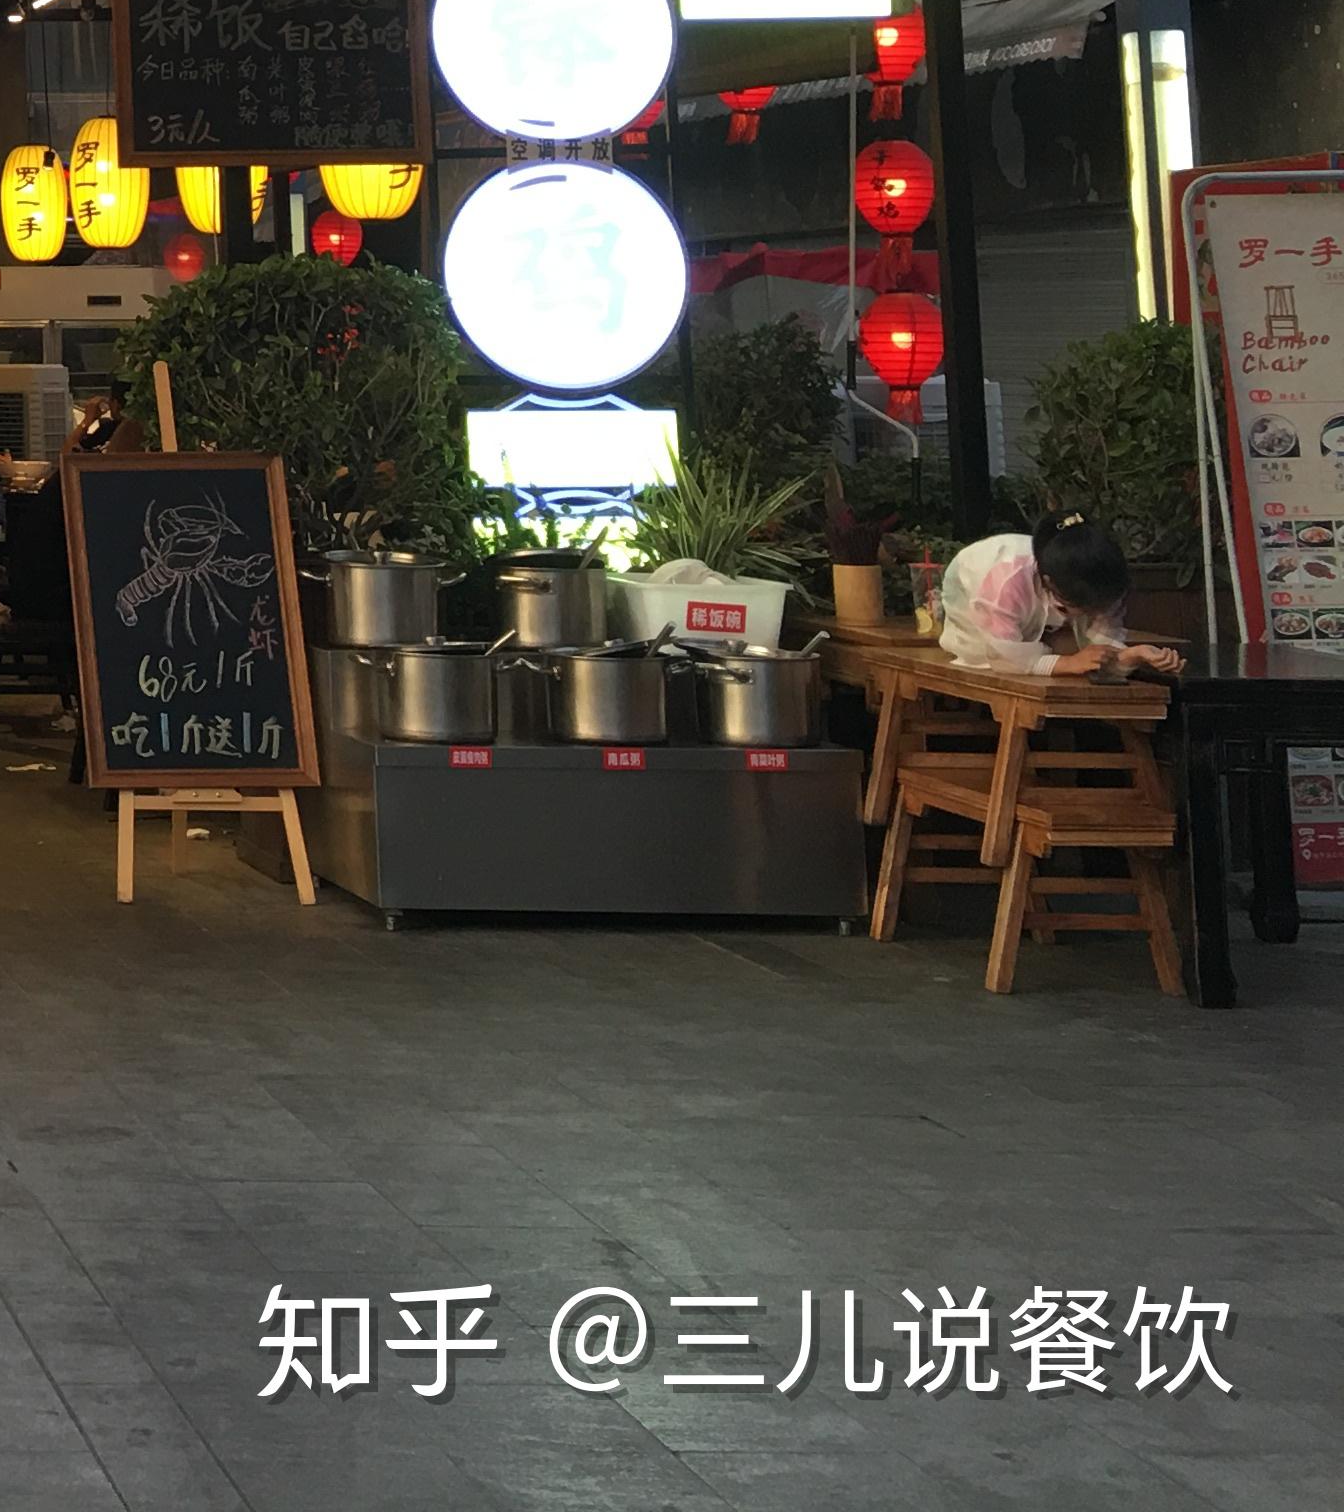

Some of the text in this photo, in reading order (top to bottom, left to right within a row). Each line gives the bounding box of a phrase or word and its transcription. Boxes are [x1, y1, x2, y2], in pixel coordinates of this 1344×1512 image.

[511, 138, 611, 161] 空调开放
[74, 141, 102, 230] 罗一手
[14, 166, 42, 242] 罗一手
[1239, 236, 1343, 269] 罗一手
[1241, 331, 1331, 351] Bamboo
[1242, 354, 1309, 374] Chair
[690, 606, 742, 631] 稀饭碗
[607, 751, 642, 767] 南瓜粥
